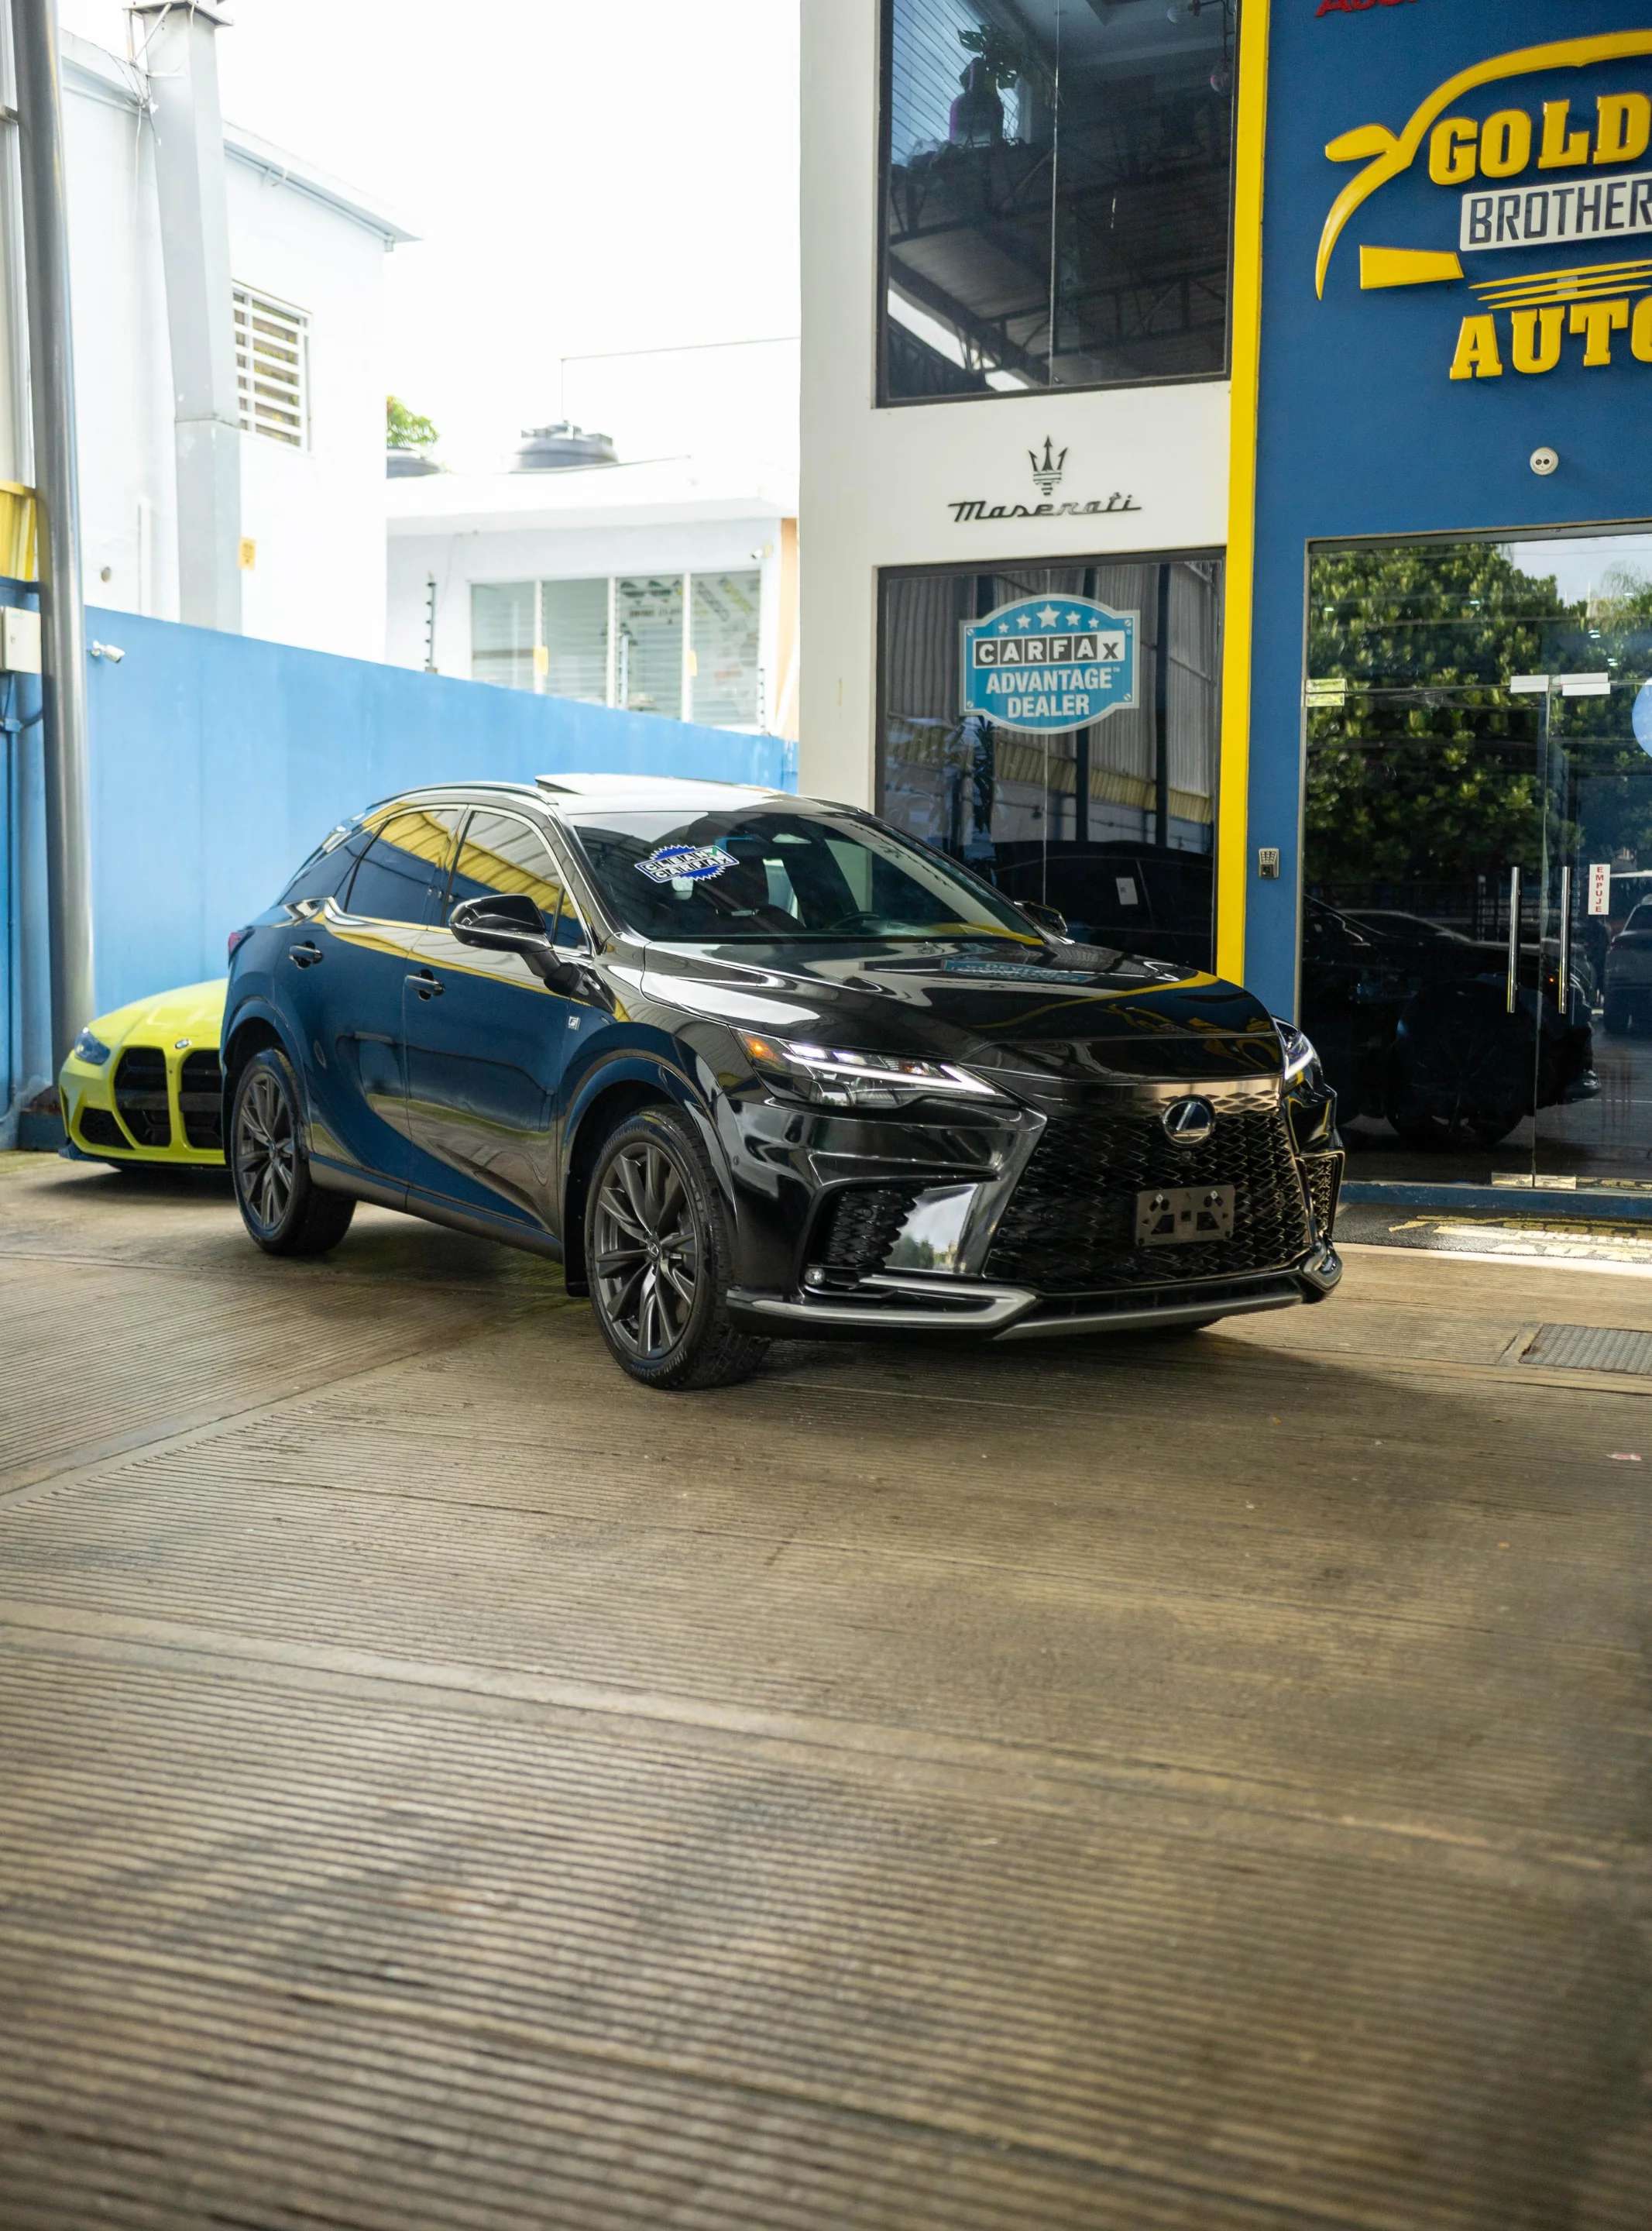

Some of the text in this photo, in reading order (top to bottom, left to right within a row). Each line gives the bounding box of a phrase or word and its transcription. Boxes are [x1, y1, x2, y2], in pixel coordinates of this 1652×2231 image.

[1429, 92, 1652, 185] GOLD
[1468, 179, 1652, 245] BROTHER
[948, 492, 1142, 522] Maserati
[978, 638, 1120, 663] CARFAX
[985, 668, 1113, 694] ADVANTAGE
[1008, 694, 1090, 718] DEALER
[644, 850, 708, 871] CLEAN
[655, 857, 731, 878] CARFAX
[1595, 866, 1604, 913] EMPUJE
